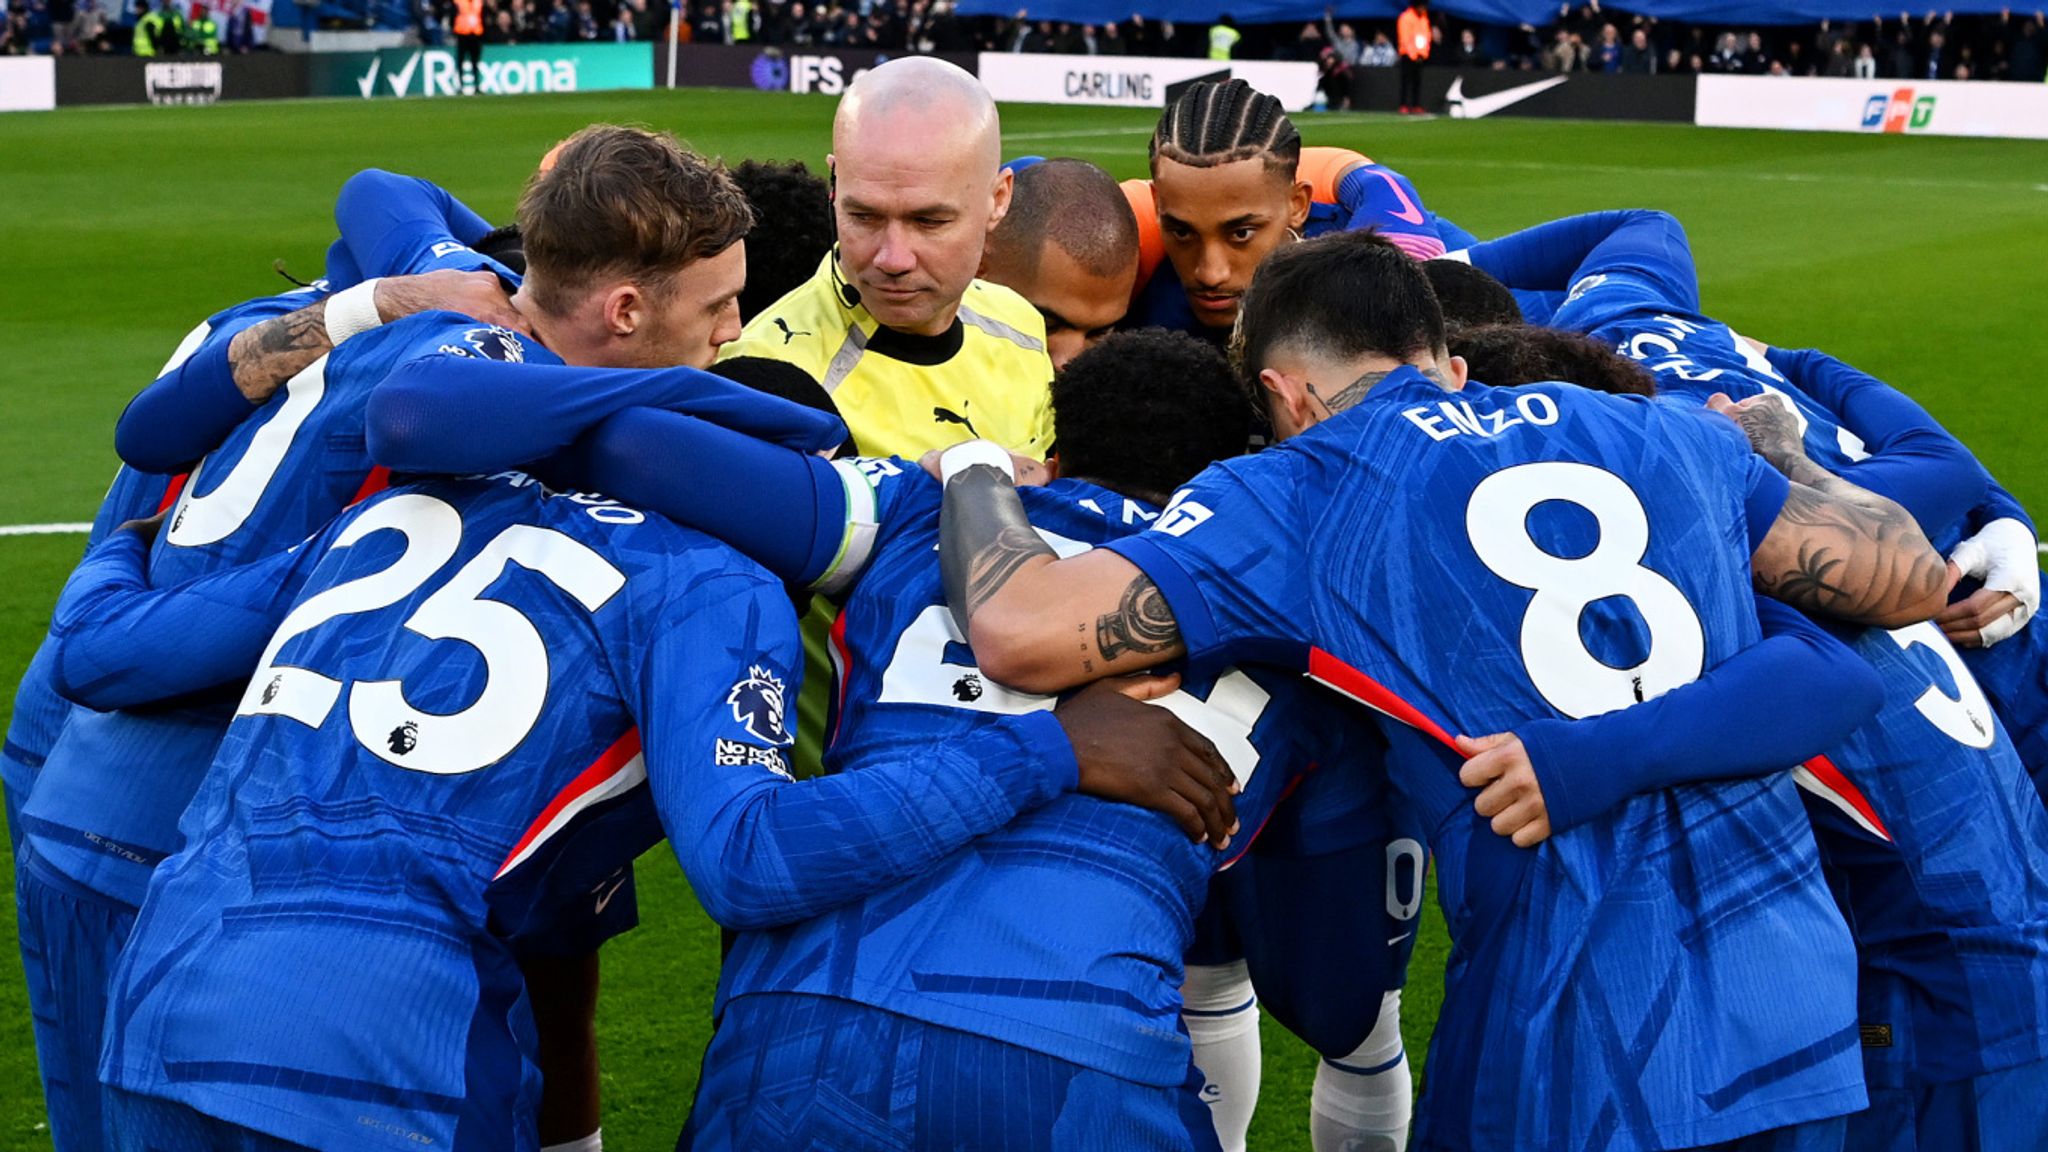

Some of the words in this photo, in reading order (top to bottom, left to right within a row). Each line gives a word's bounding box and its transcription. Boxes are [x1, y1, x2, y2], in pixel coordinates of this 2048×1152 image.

[1064, 70, 1153, 100] CARLING
[1861, 88, 1937, 133] FPT
[1402, 393, 1559, 442] ENZO
[1465, 461, 1705, 720] 8
[231, 493, 629, 776] 25
